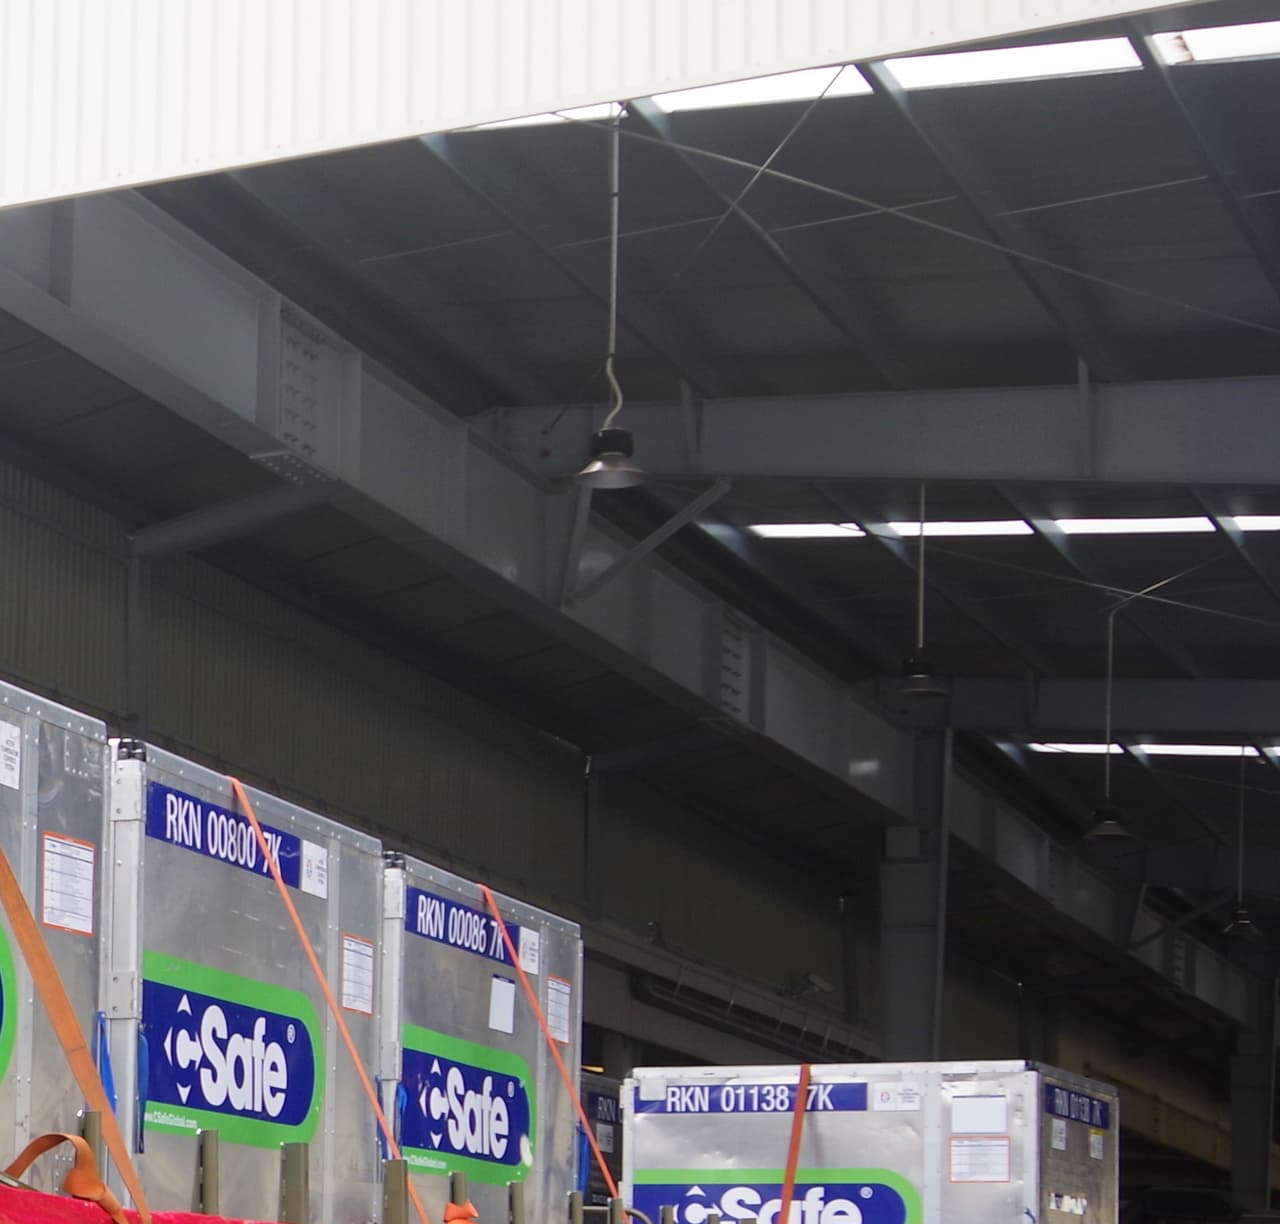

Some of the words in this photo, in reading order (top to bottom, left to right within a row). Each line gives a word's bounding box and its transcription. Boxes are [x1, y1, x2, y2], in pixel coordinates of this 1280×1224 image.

[165, 793, 202, 850] RKN
[207, 811, 256, 869] 00800
[417, 895, 446, 940] RKN
[448, 907, 487, 954] 00086
[666, 1086, 710, 1112] RKN
[720, 1085, 790, 1112] 01138
[805, 1084, 835, 1111] 7K
